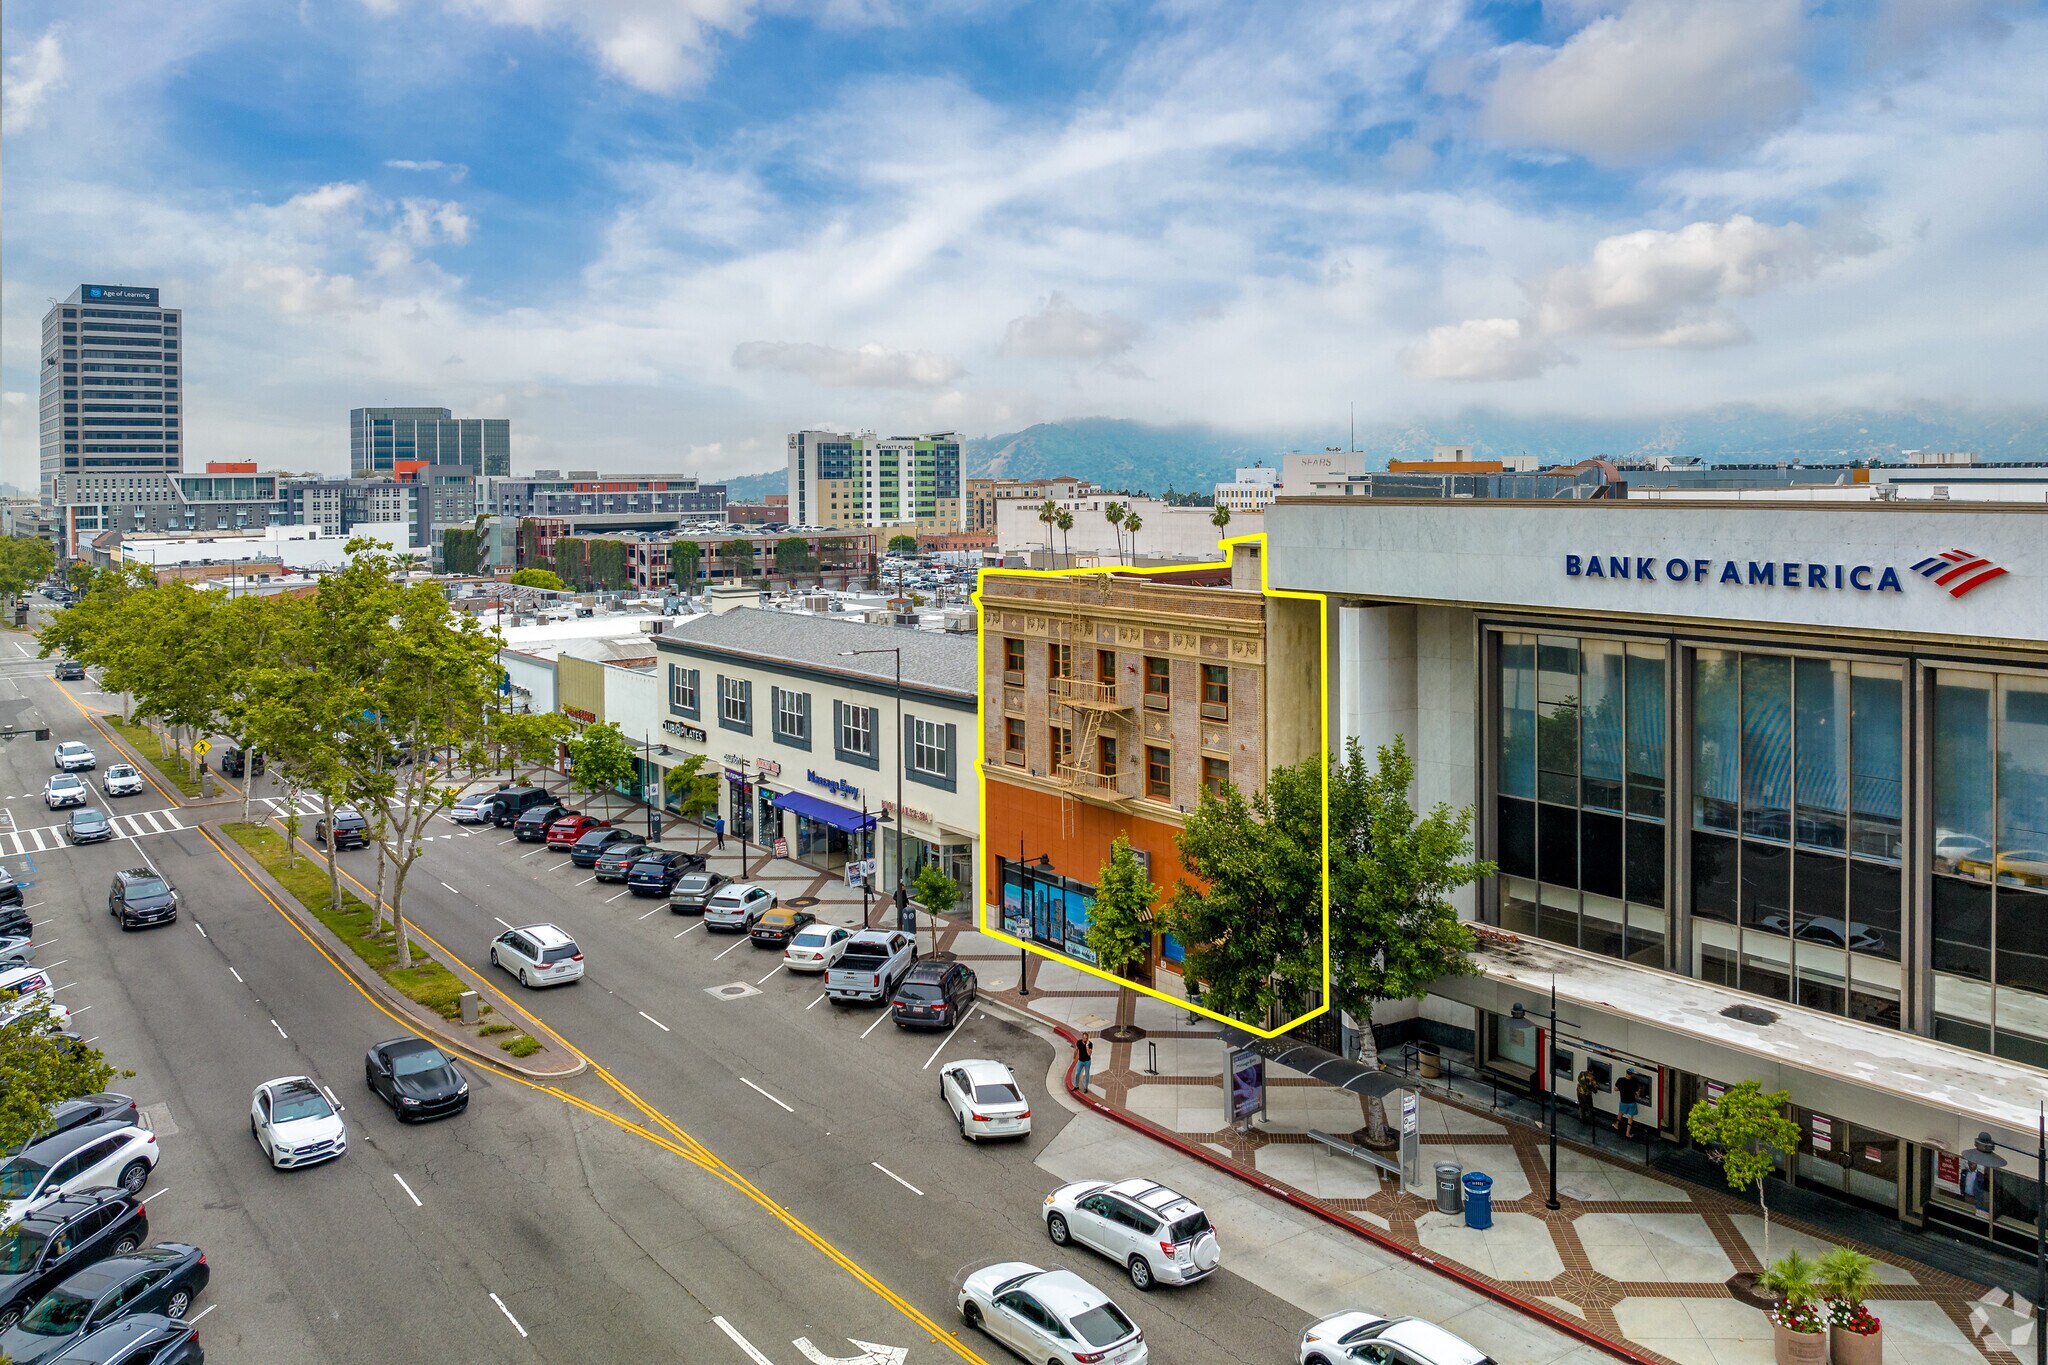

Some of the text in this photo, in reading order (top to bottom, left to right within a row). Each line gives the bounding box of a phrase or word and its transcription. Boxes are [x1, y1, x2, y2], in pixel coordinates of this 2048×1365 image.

[124, 291, 150, 299] Learning
[1301, 458, 1332, 467] SEARS
[1565, 554, 1904, 592] BANK OF AMERICA
[807, 769, 859, 800] Massage Envy
